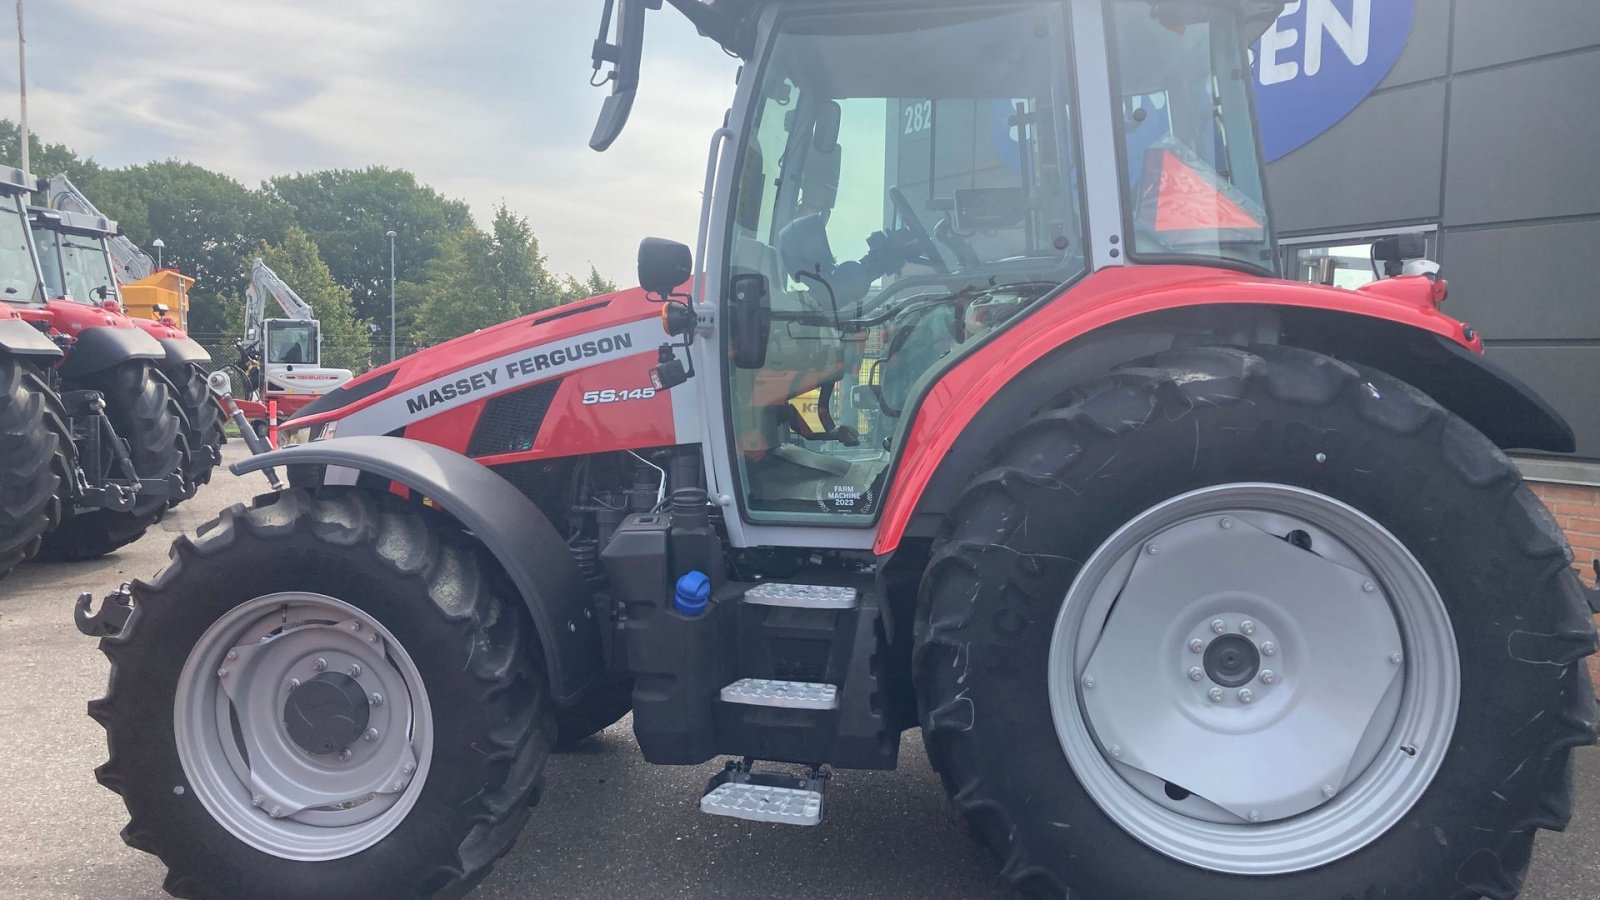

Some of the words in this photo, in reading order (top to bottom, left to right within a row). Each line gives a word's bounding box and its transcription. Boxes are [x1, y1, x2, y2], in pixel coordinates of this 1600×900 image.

[904, 99, 932, 135] 282
[406, 367, 499, 414] MASSEY
[505, 332, 633, 380] FERGUSON
[582, 386, 656, 405] 5S.145
